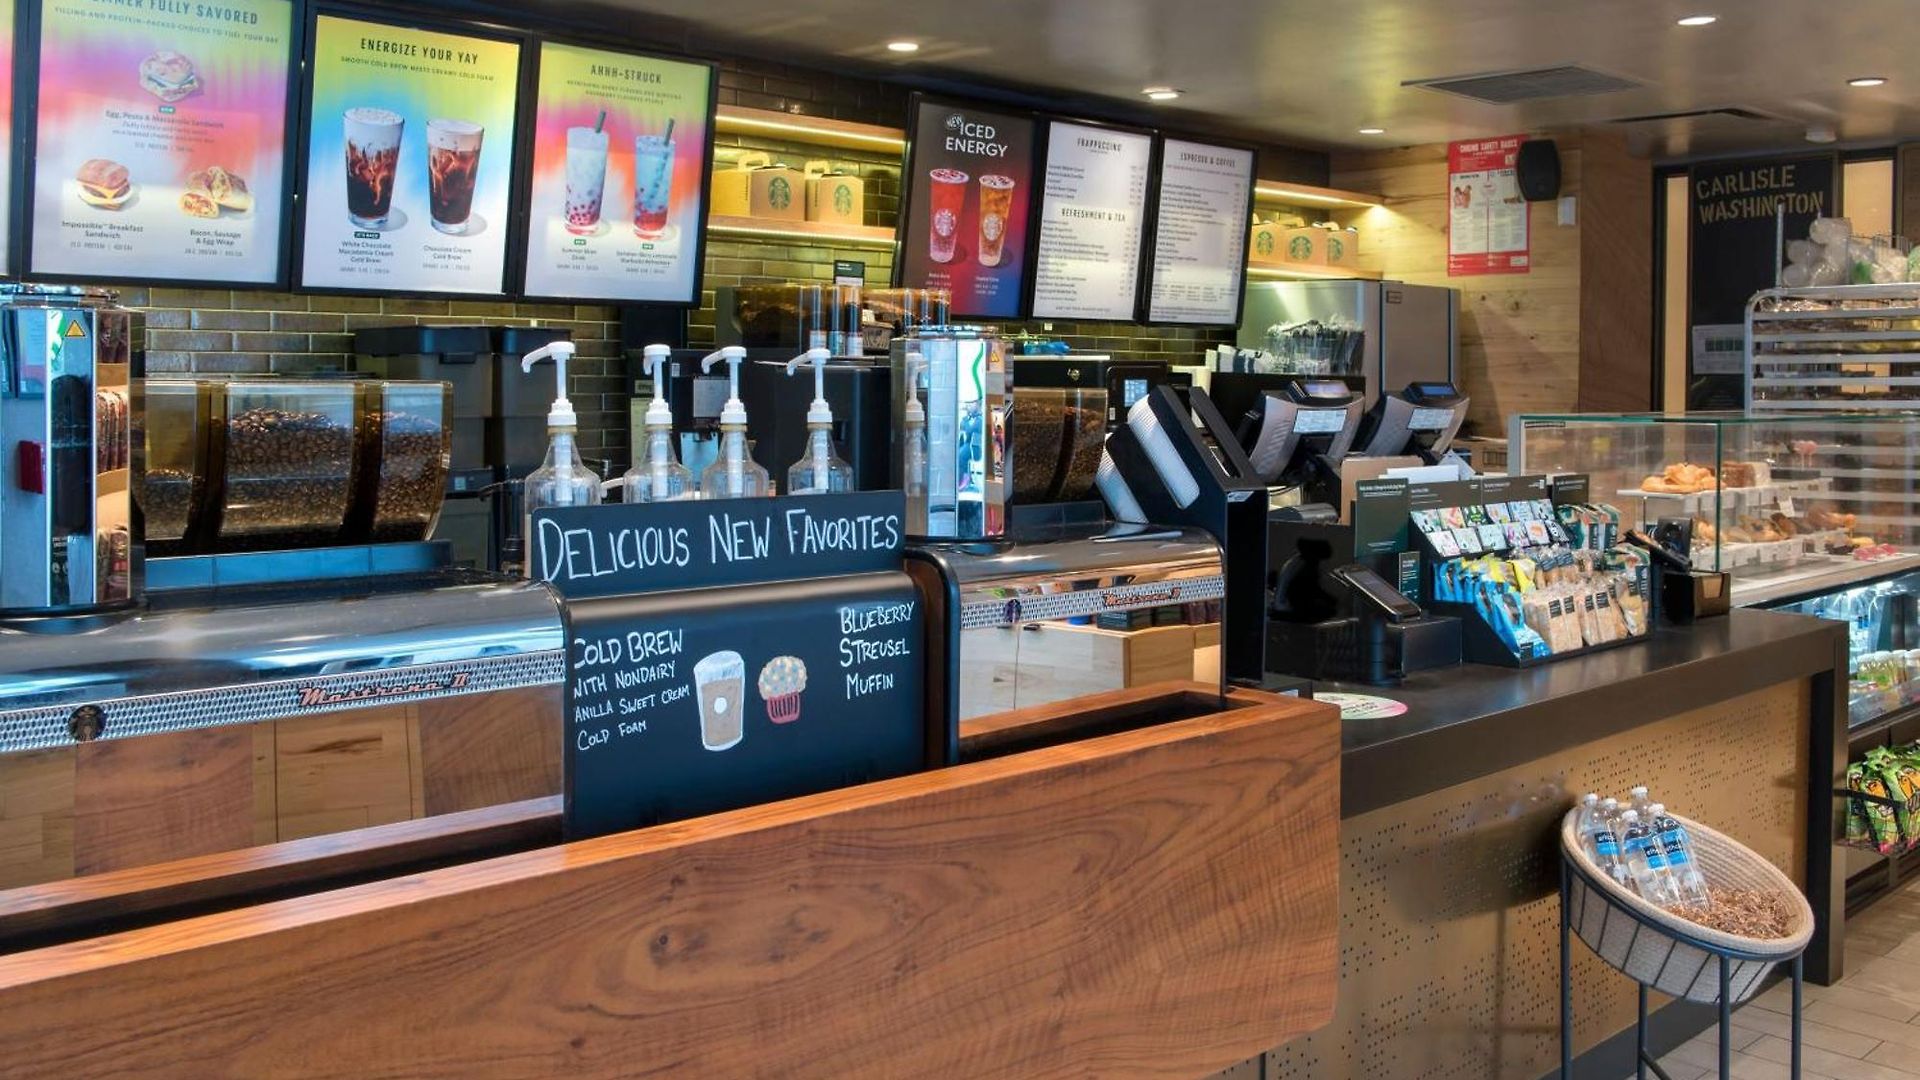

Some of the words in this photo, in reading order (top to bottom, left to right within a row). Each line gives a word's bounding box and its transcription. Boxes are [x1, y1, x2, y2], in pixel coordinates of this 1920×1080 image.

[150, 0, 190, 14] FULLY
[196, 4, 258, 25] SAVORED
[341, 56, 369, 65] SMOOTH
[361, 38, 417, 56] ENERGIZE
[422, 47, 452, 61] YOUR
[457, 52, 479, 65] YAY
[960, 122, 996, 139] ICED
[946, 136, 1008, 157] ENERGY
[1696, 165, 1796, 199] CARLISLE
[1061, 208, 1106, 220] REFRESHMENT
[1115, 213, 1126, 222] TEA
[1699, 191, 1825, 225] WASHINGTON
[538, 517, 691, 582] DELICIOUS
[709, 513, 770, 564] NEW
[785, 508, 899, 555] FAVORITES
[840, 601, 915, 634] BLUEBERRY
[574, 637, 622, 670] COLD
[626, 628, 683, 662] BREW
[840, 638, 910, 667] STREUSEL
[614, 660, 676, 689] NONDAIRY
[846, 672, 894, 700] MUFFIN
[299, 682, 444, 706] Mastrena
[574, 700, 614, 724] ANILLA
[619, 694, 656, 715] SWEET
[661, 684, 690, 705] CREAM
[577, 729, 610, 751] COLD
[618, 720, 647, 737] FOAM
